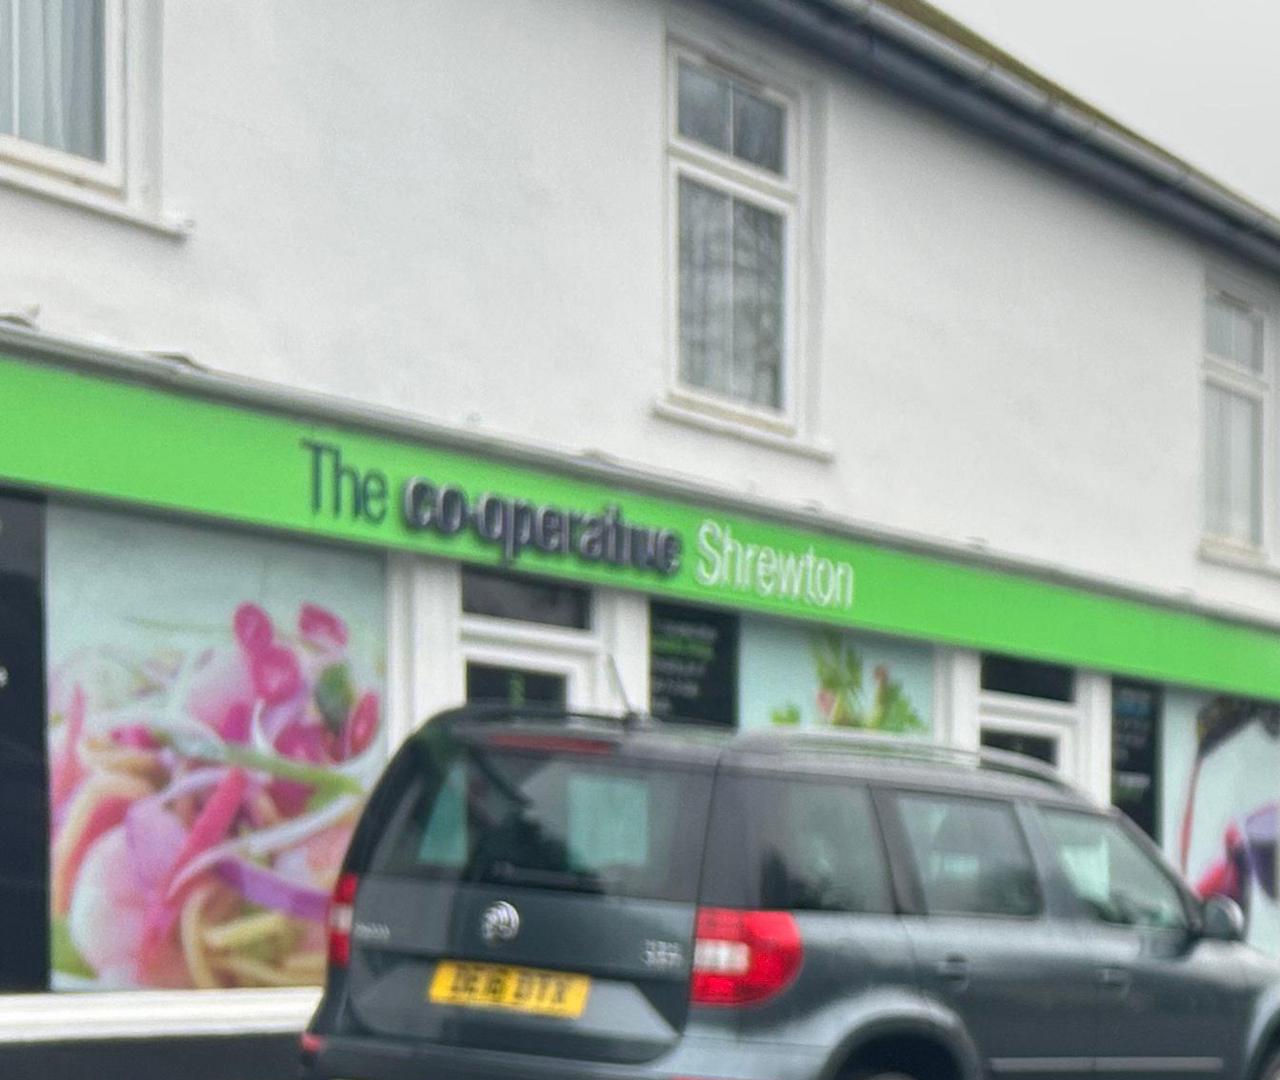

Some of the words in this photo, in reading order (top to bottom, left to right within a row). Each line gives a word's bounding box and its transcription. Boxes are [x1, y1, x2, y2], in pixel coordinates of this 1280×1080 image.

[302, 440, 389, 524] The
[402, 475, 683, 580] co-operative
[694, 518, 856, 609] Shrewton
